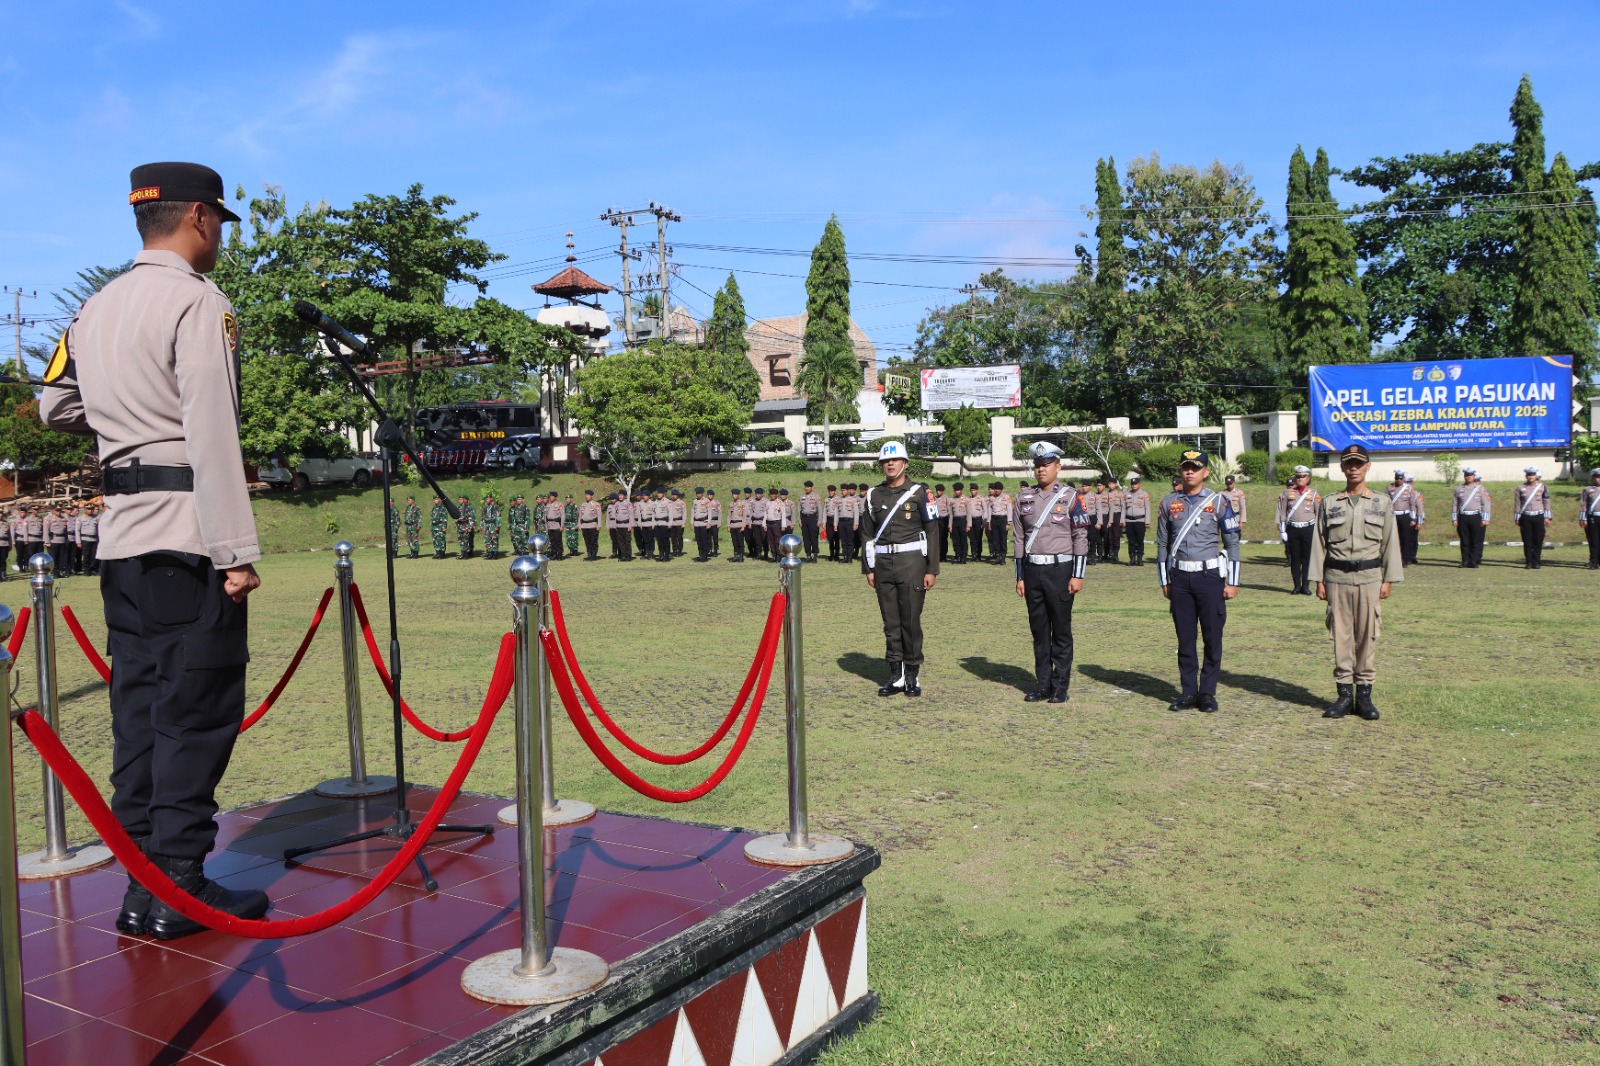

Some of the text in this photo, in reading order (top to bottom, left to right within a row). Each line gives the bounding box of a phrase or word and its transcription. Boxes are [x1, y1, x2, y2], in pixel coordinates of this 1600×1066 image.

[1323, 382, 1555, 407] APEL GELAR PASUKAN
[1331, 405, 1548, 422] OPERASI ZEBRA KRAKATAU 2025
[1370, 420, 1505, 432] POLRES LAMPUNG UTARA
[460, 431, 506, 440] BRIMOB
[883, 445, 896, 455] PM
